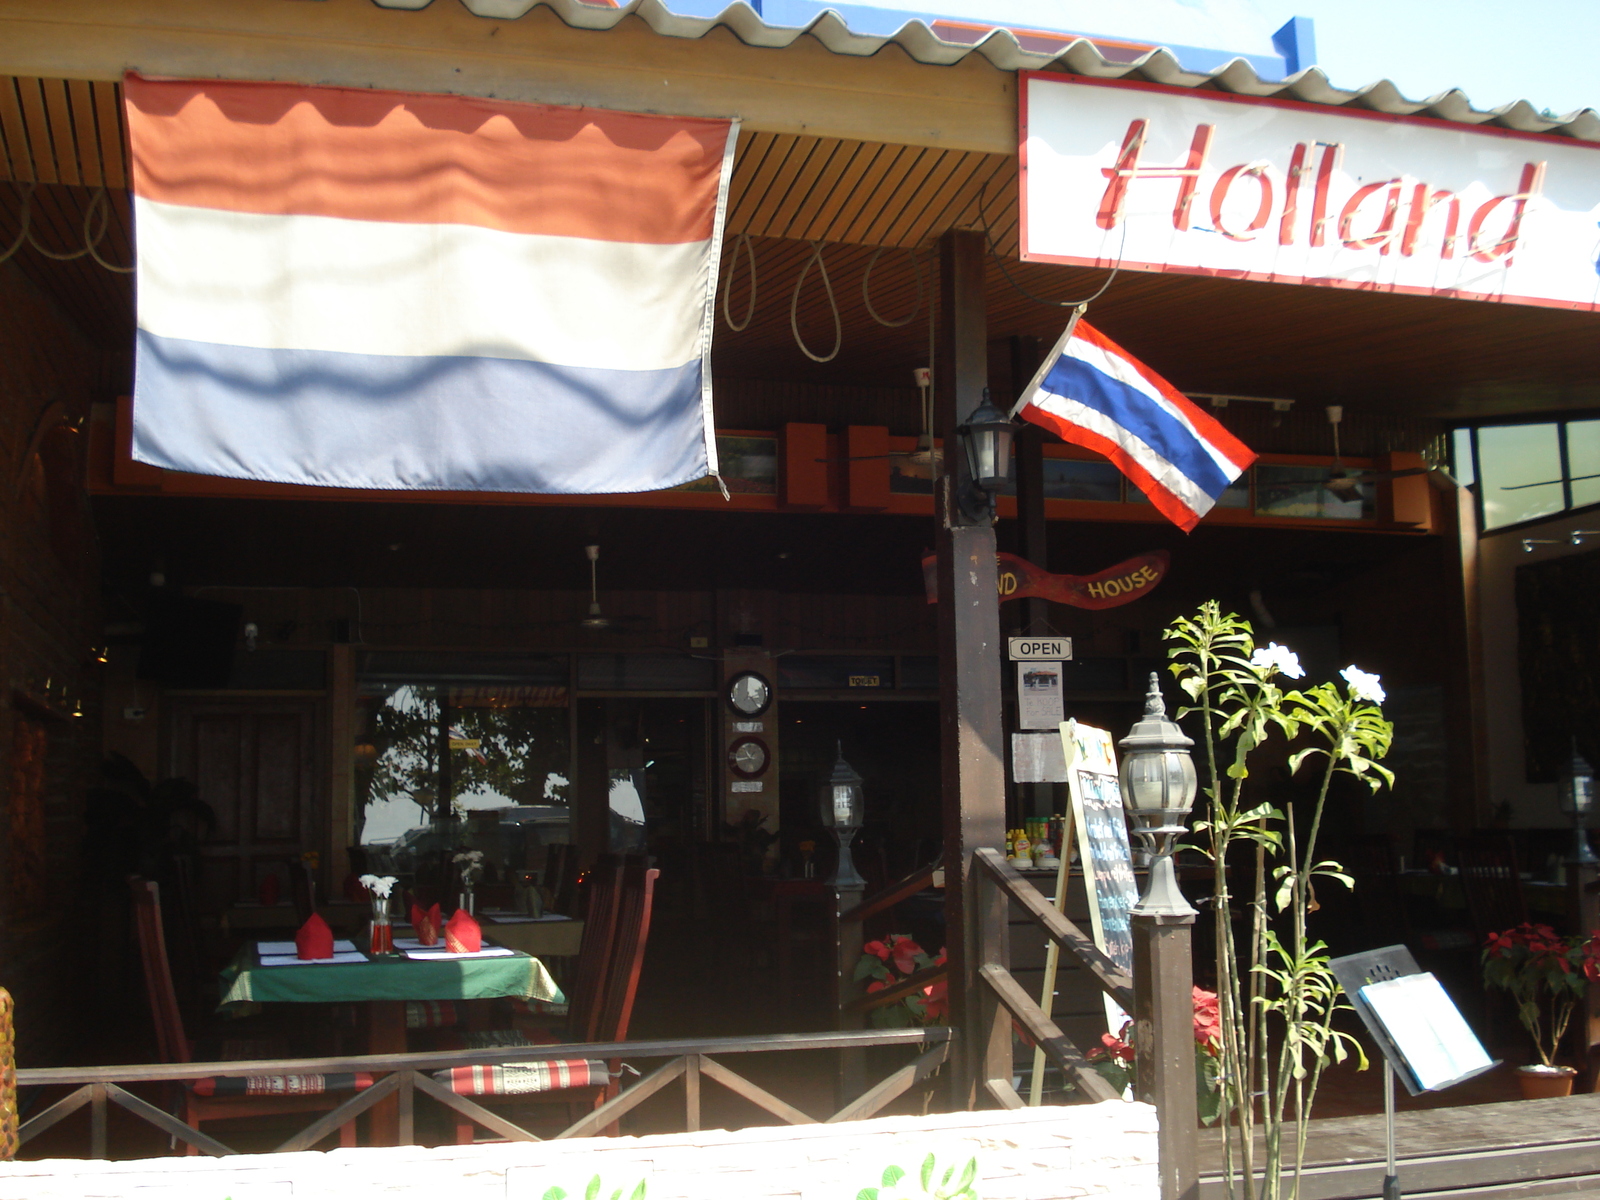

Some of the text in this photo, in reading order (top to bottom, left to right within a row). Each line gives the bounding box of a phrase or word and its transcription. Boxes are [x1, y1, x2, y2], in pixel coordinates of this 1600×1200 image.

[1096, 117, 1547, 268] Holland
[1087, 565, 1159, 600] HOUSE
[1020, 642, 1062, 655] OPEN
[1041, 706, 1062, 716] SALE
